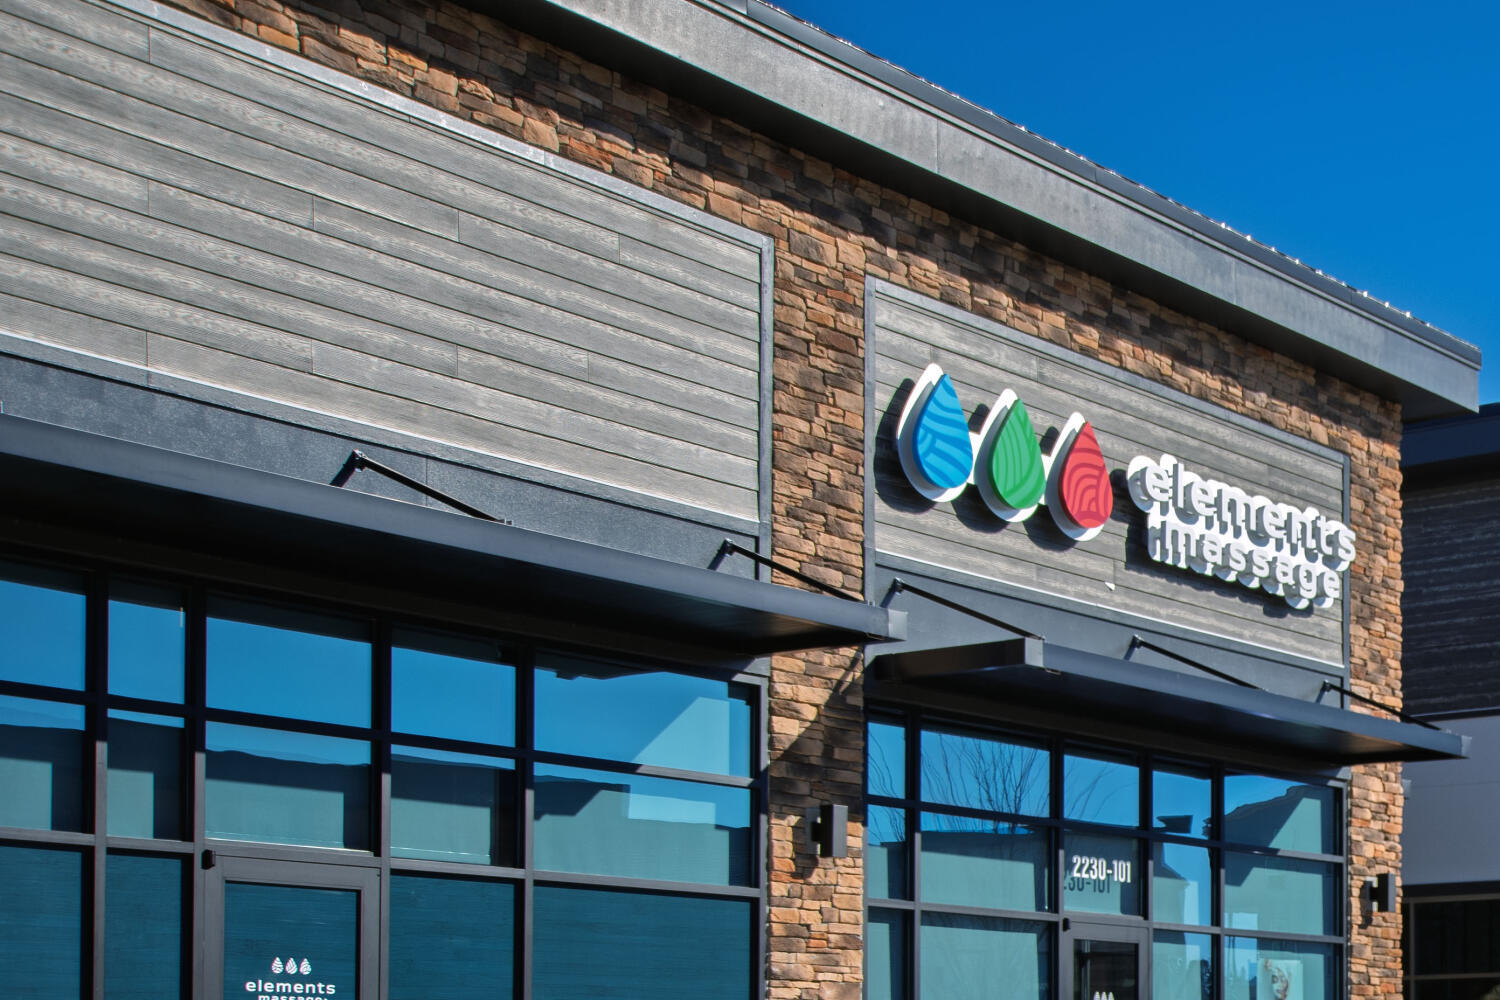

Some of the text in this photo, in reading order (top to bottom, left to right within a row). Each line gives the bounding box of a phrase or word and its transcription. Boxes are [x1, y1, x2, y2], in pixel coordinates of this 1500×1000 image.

[1136, 458, 1356, 566] elements
[1154, 518, 1340, 604] massage
[1071, 855, 1132, 884] 2230-101
[245, 979, 337, 995] elements
